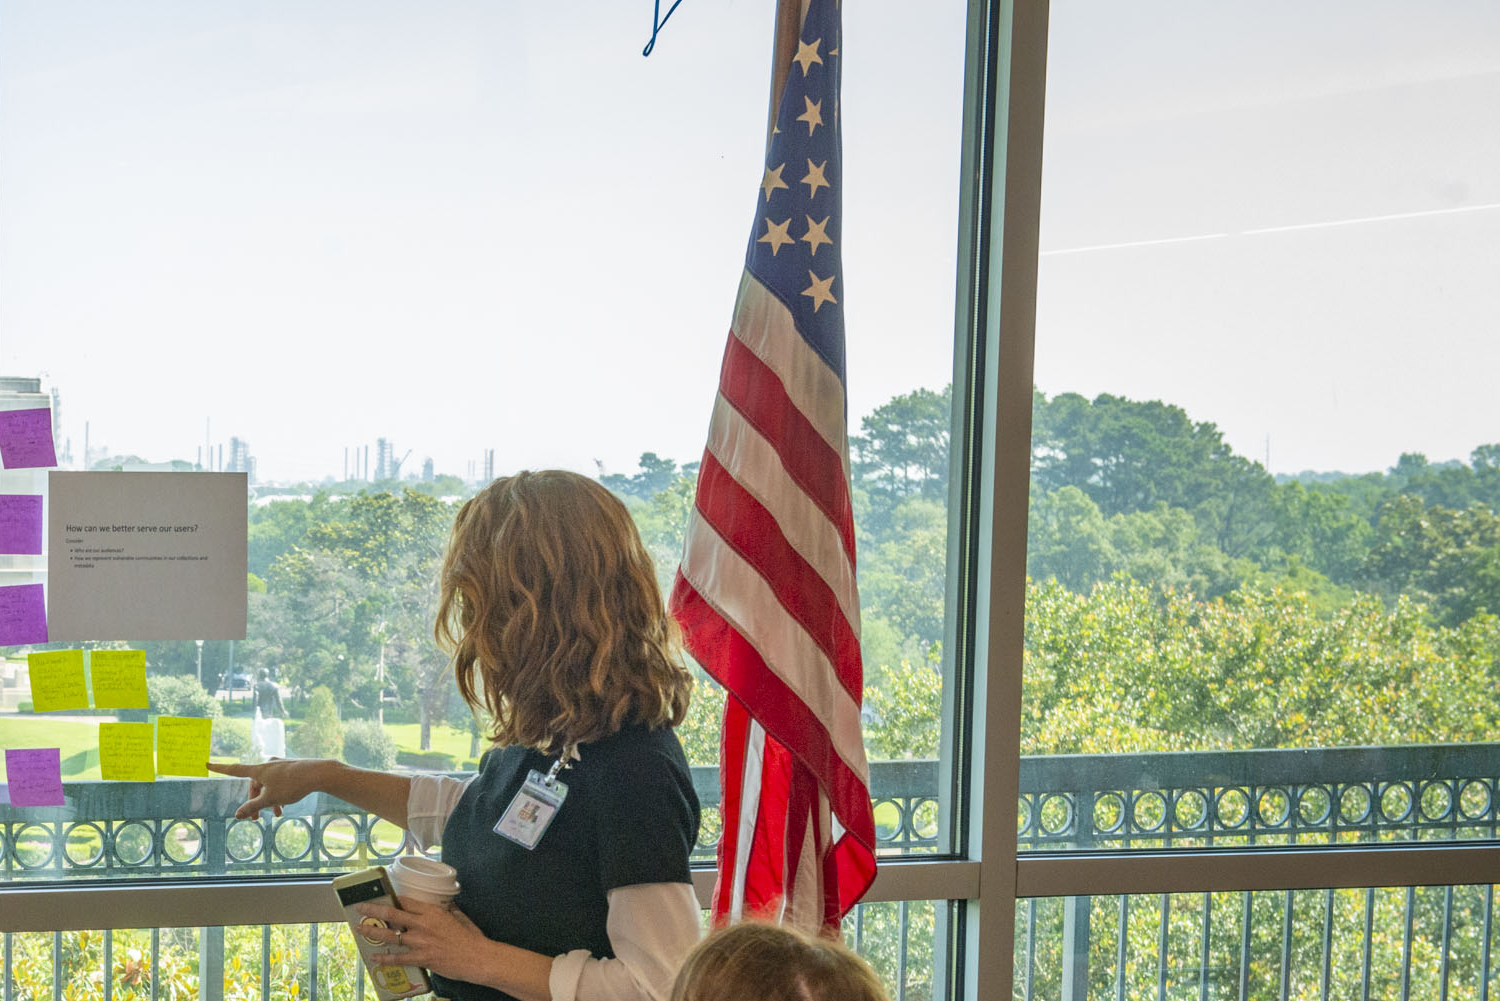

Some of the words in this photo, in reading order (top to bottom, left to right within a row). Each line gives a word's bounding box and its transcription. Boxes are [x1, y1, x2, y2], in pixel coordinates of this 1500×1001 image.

[66, 524, 83, 532] How
[112, 524, 135, 532] better
[174, 524, 198, 532] users?
